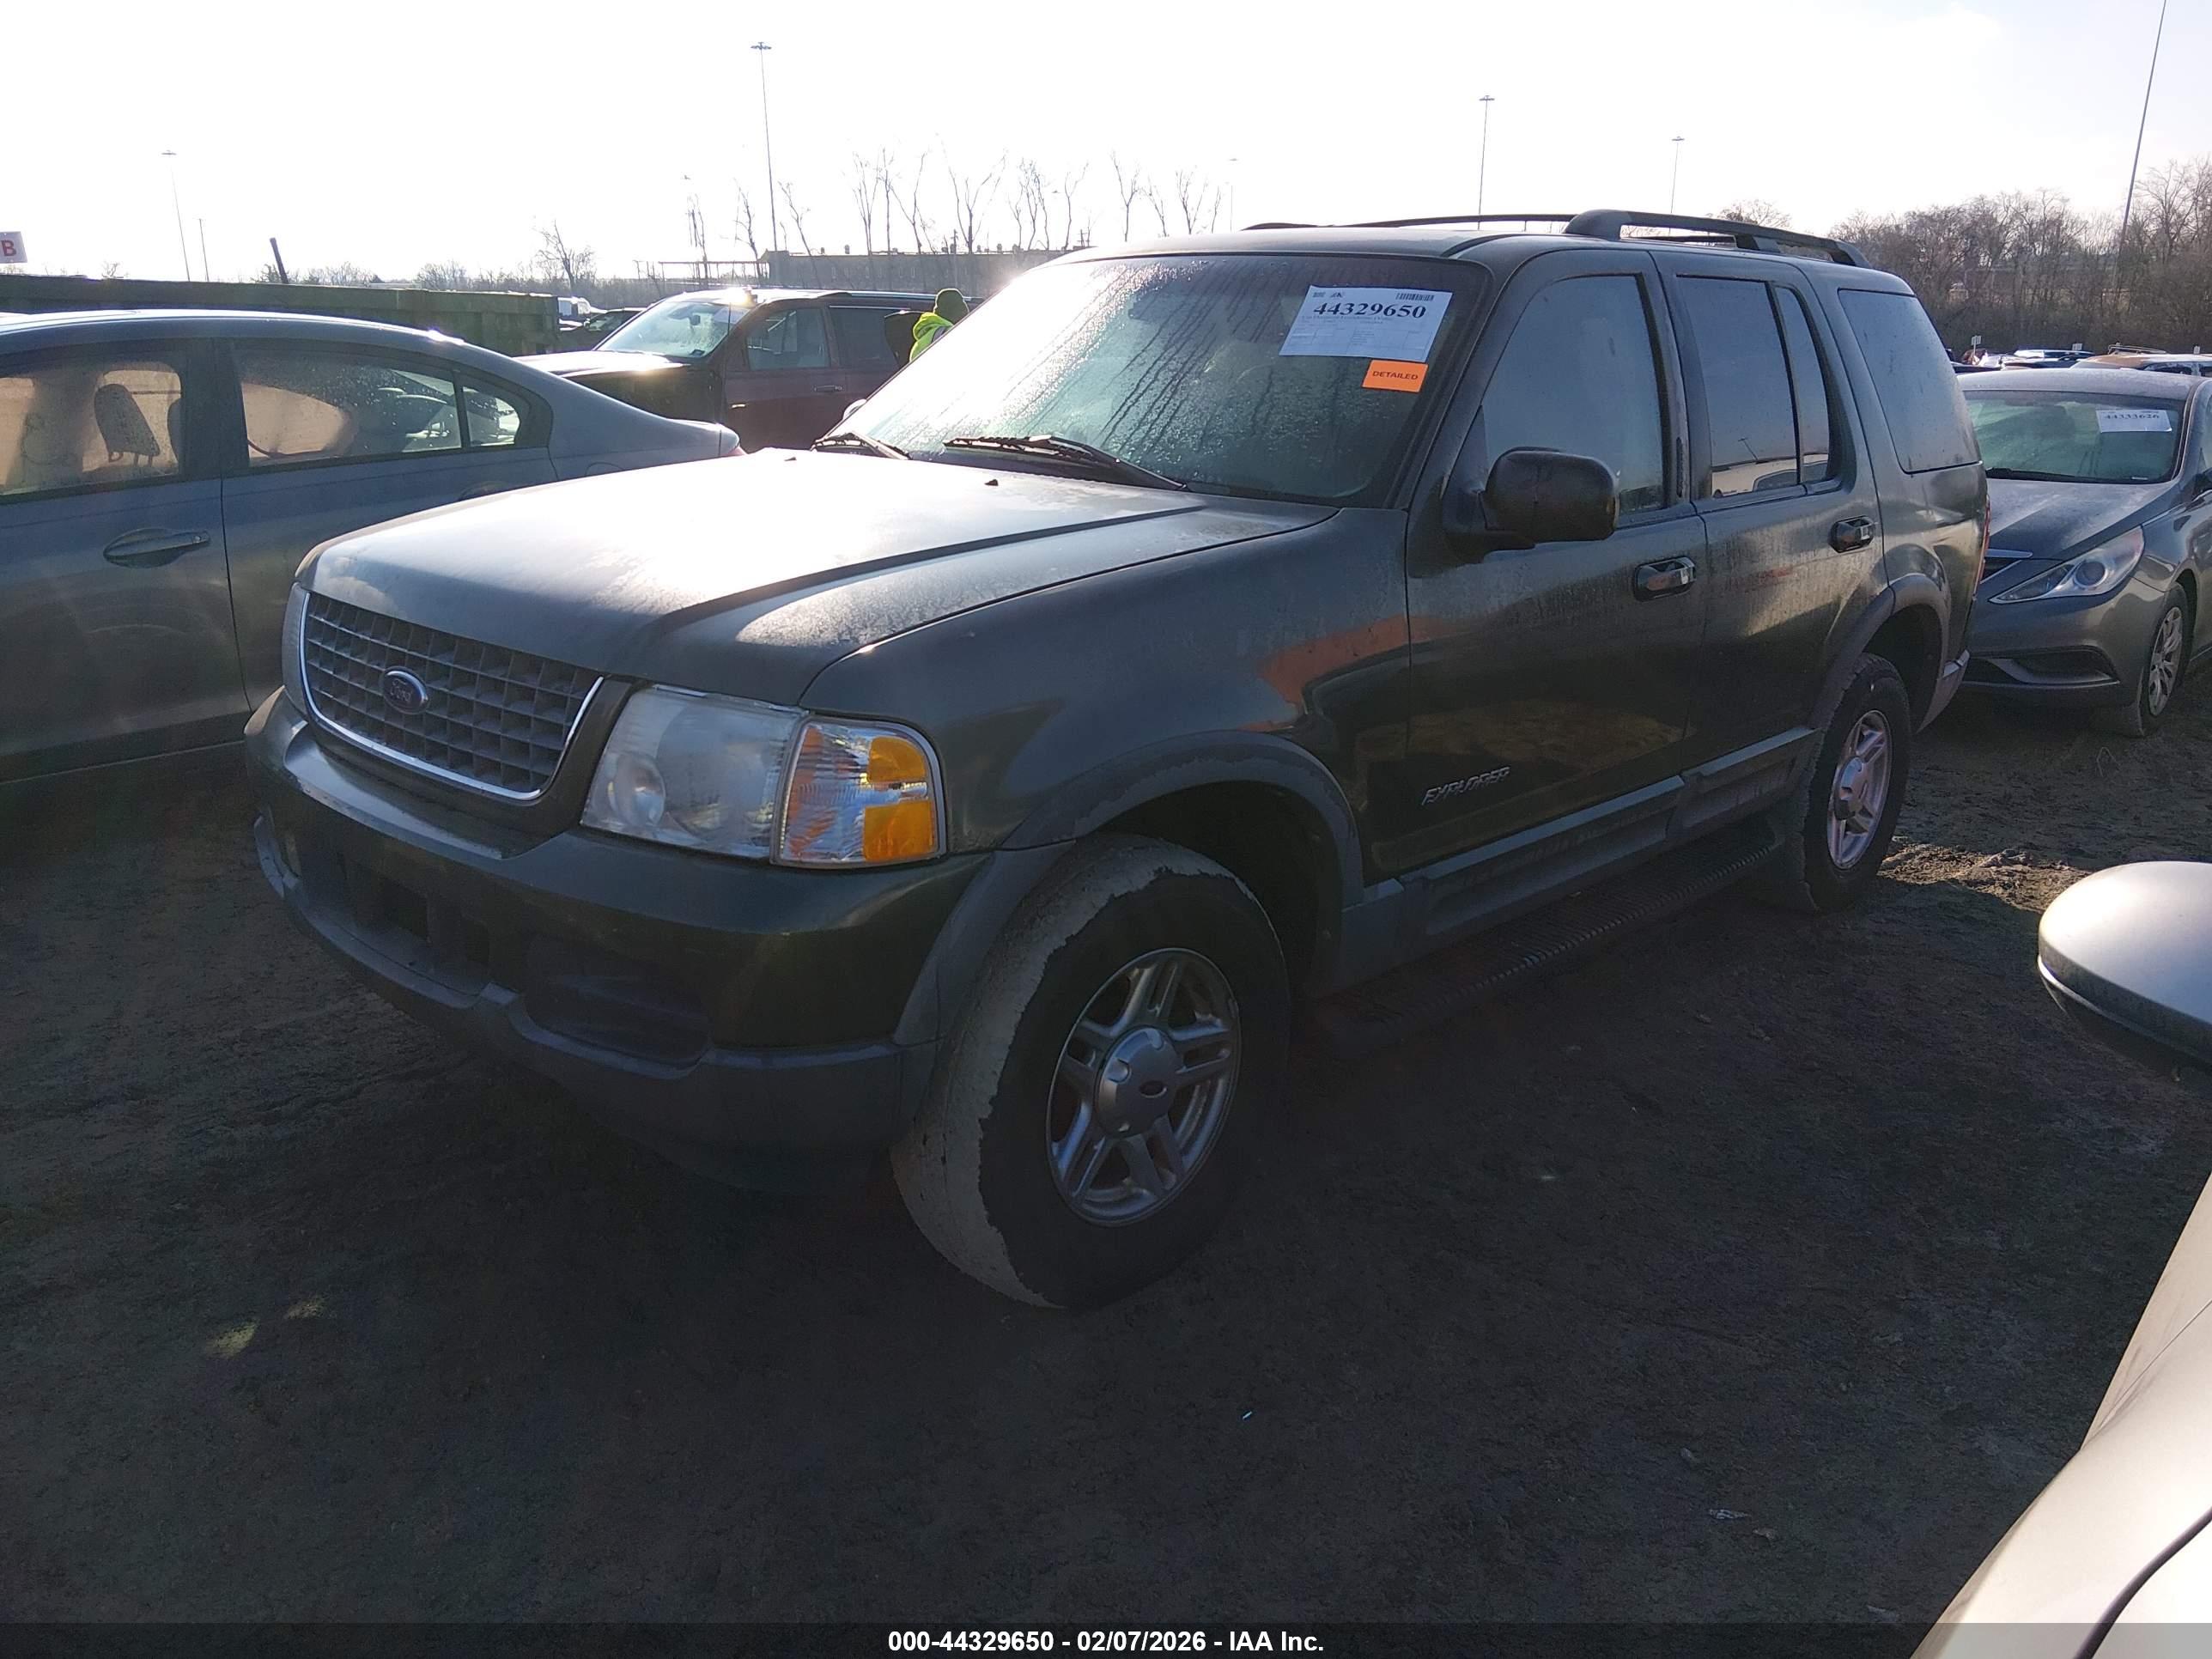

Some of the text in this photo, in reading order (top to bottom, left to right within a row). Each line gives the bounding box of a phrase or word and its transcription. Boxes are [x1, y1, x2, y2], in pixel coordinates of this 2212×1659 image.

[1, 240, 17, 257] B
[1313, 302, 1427, 319] 44329650
[1372, 370, 1419, 381] DETAILED
[1421, 767, 1510, 805] EXPLORER
